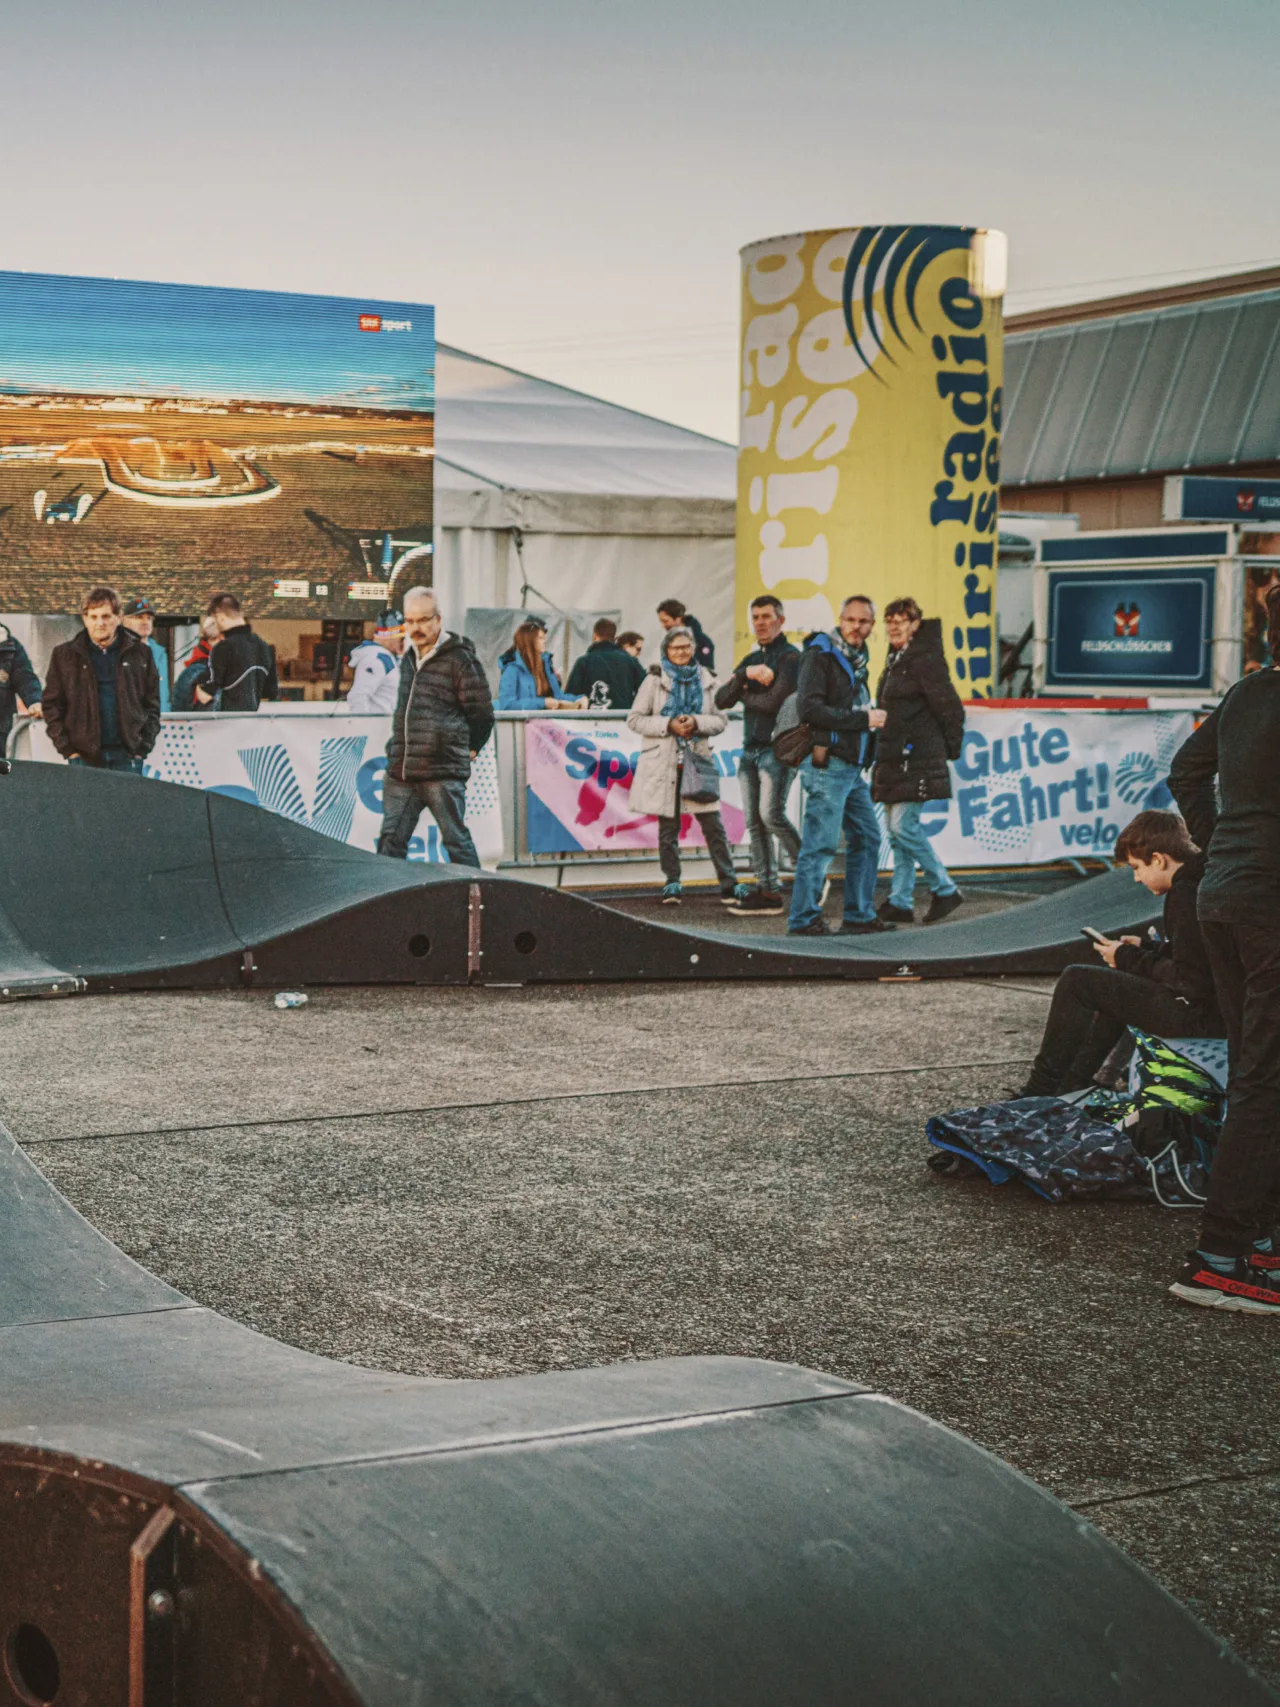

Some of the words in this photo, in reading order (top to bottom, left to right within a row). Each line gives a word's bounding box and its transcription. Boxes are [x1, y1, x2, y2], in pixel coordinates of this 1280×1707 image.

[929, 276, 989, 527] radio
[954, 722, 1070, 782] Gute
[957, 762, 1110, 838] Fahrt!
[1060, 816, 1119, 848] velo
